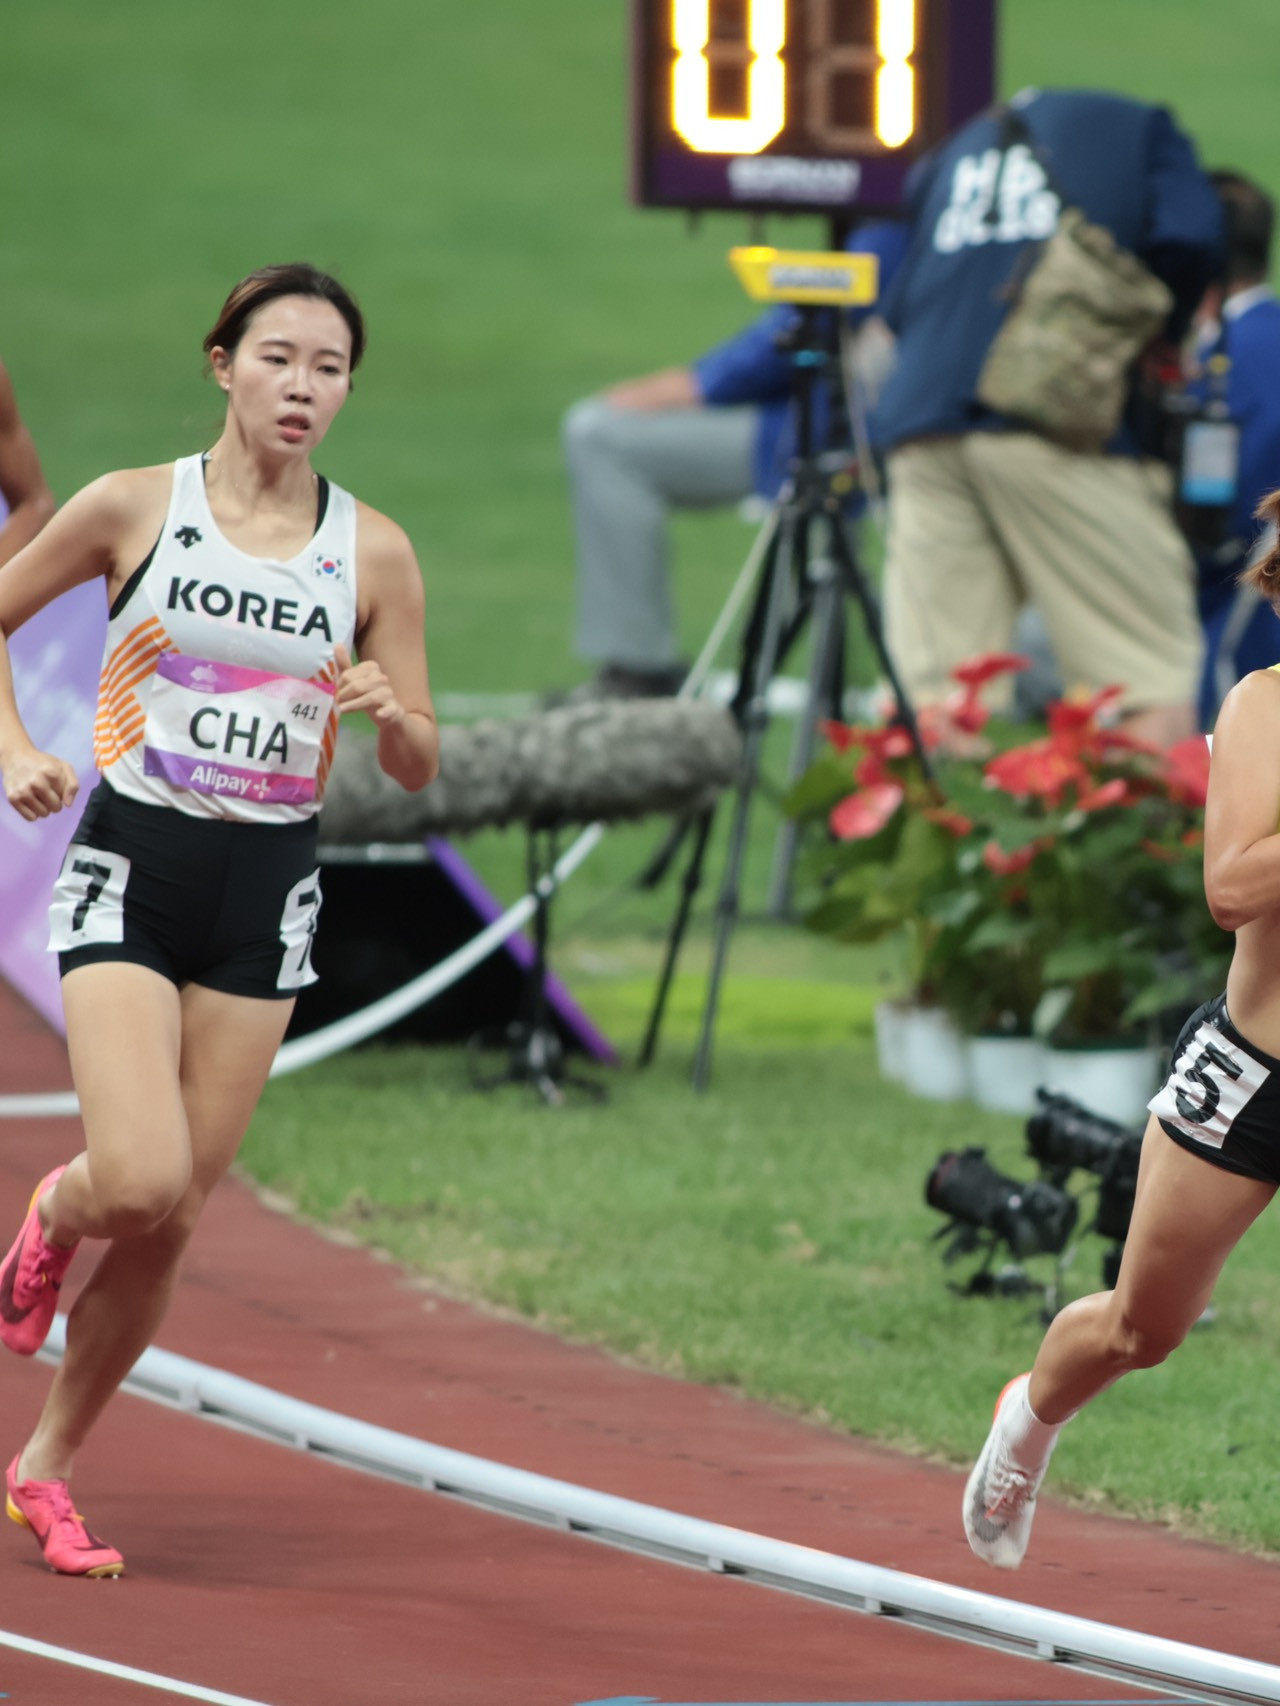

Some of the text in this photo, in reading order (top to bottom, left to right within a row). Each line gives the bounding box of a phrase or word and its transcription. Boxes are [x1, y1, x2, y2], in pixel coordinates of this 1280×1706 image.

[167, 577, 333, 643] KOREA
[190, 707, 289, 764] CHA
[291, 703, 318, 720] 441
[72, 858, 112, 932] 7
[1175, 1041, 1244, 1124] 5
